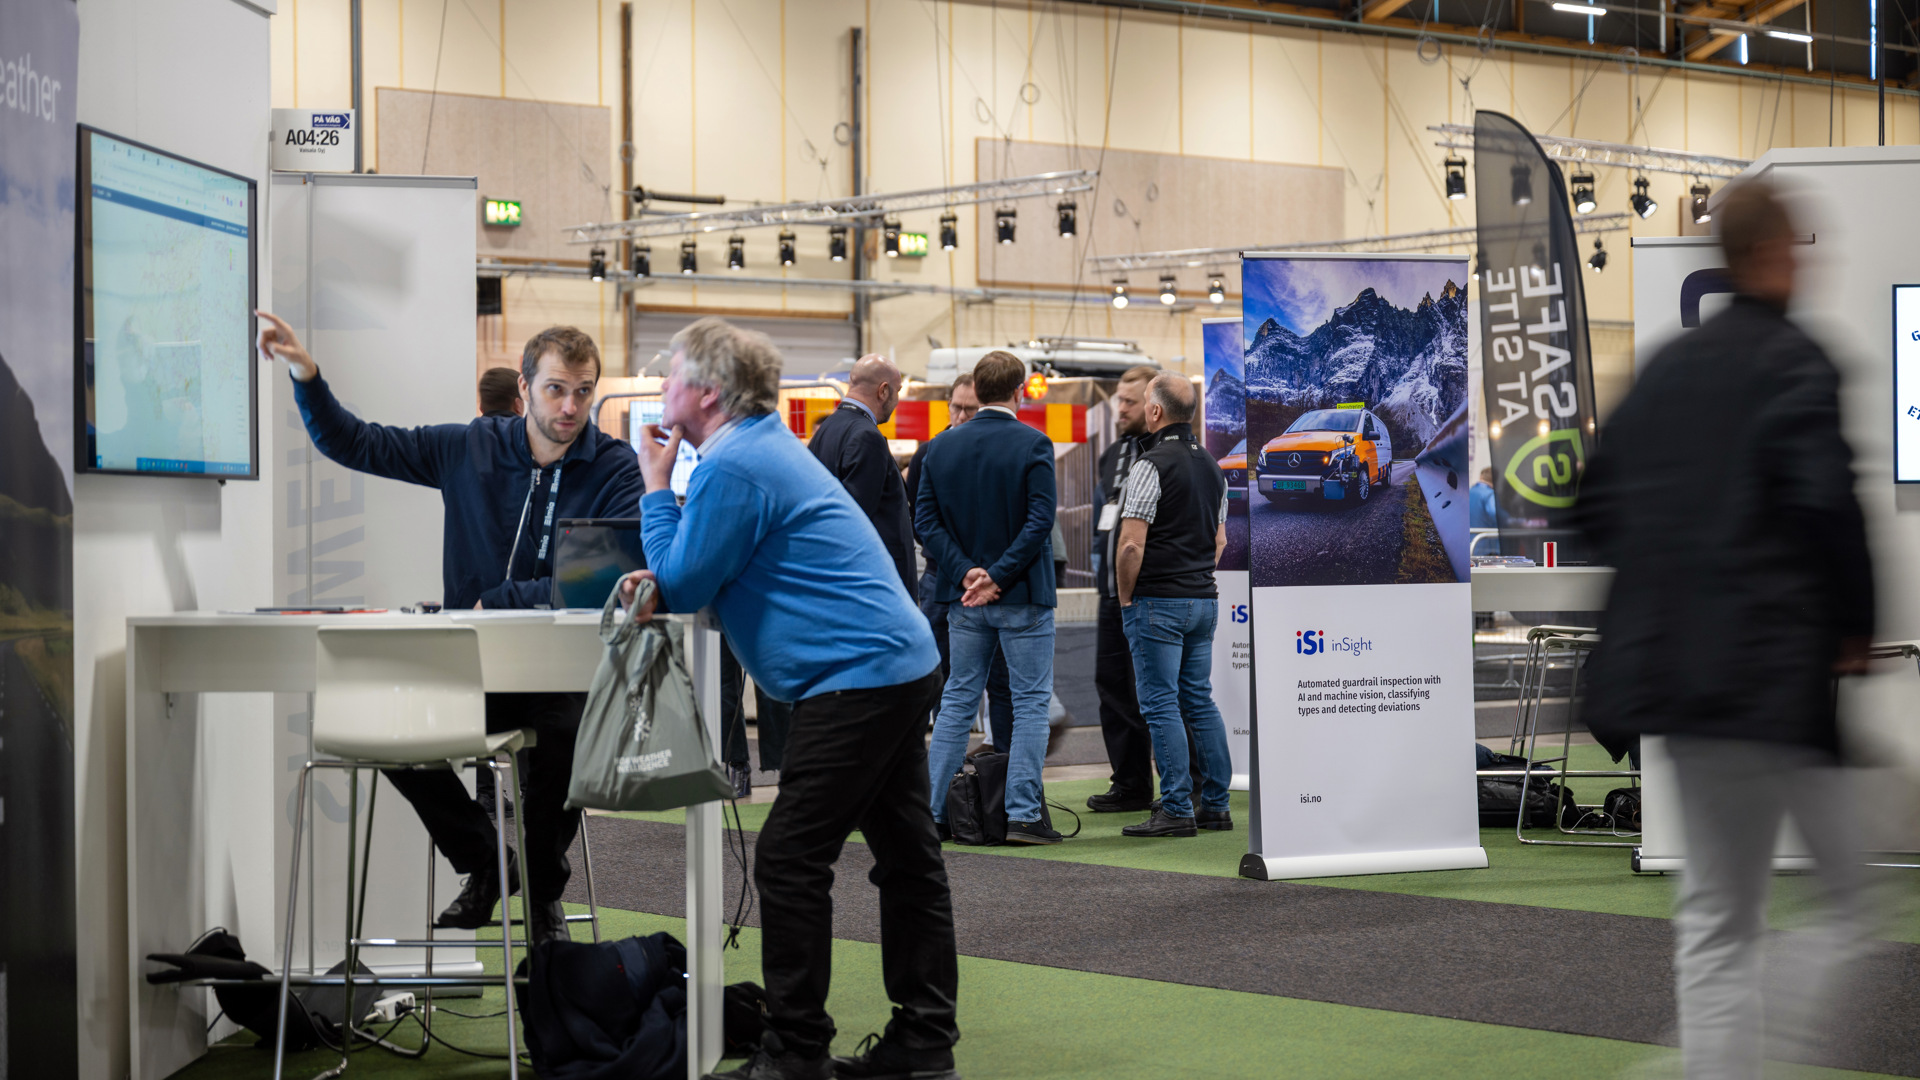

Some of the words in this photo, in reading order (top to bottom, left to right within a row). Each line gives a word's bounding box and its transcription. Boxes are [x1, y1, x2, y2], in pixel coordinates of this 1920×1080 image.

[326, 115, 341, 124] VÄG
[285, 129, 340, 146] A04:26
[550, 468, 560, 493] Elmia
[544, 501, 555, 526] Elmia
[538, 535, 549, 560] Elmia
[1232, 604, 1248, 624] iS
[1296, 630, 1324, 655] iSi
[1332, 636, 1372, 656] inSight
[1232, 662, 1250, 670] types
[1298, 678, 1340, 688] Automated
[1342, 676, 1378, 690] guardrail
[1380, 676, 1422, 688] inspection
[1424, 674, 1441, 684] with
[1298, 692, 1306, 702] AI
[1308, 692, 1322, 701] and
[1324, 690, 1358, 700] machine
[1360, 690, 1386, 700] vision,
[1388, 688, 1430, 700] classifying
[1298, 706, 1320, 716] types
[1322, 704, 1336, 714] and
[1338, 702, 1376, 714] detecting
[1378, 702, 1420, 712] deviations
[1300, 794, 1322, 804] isi.no
